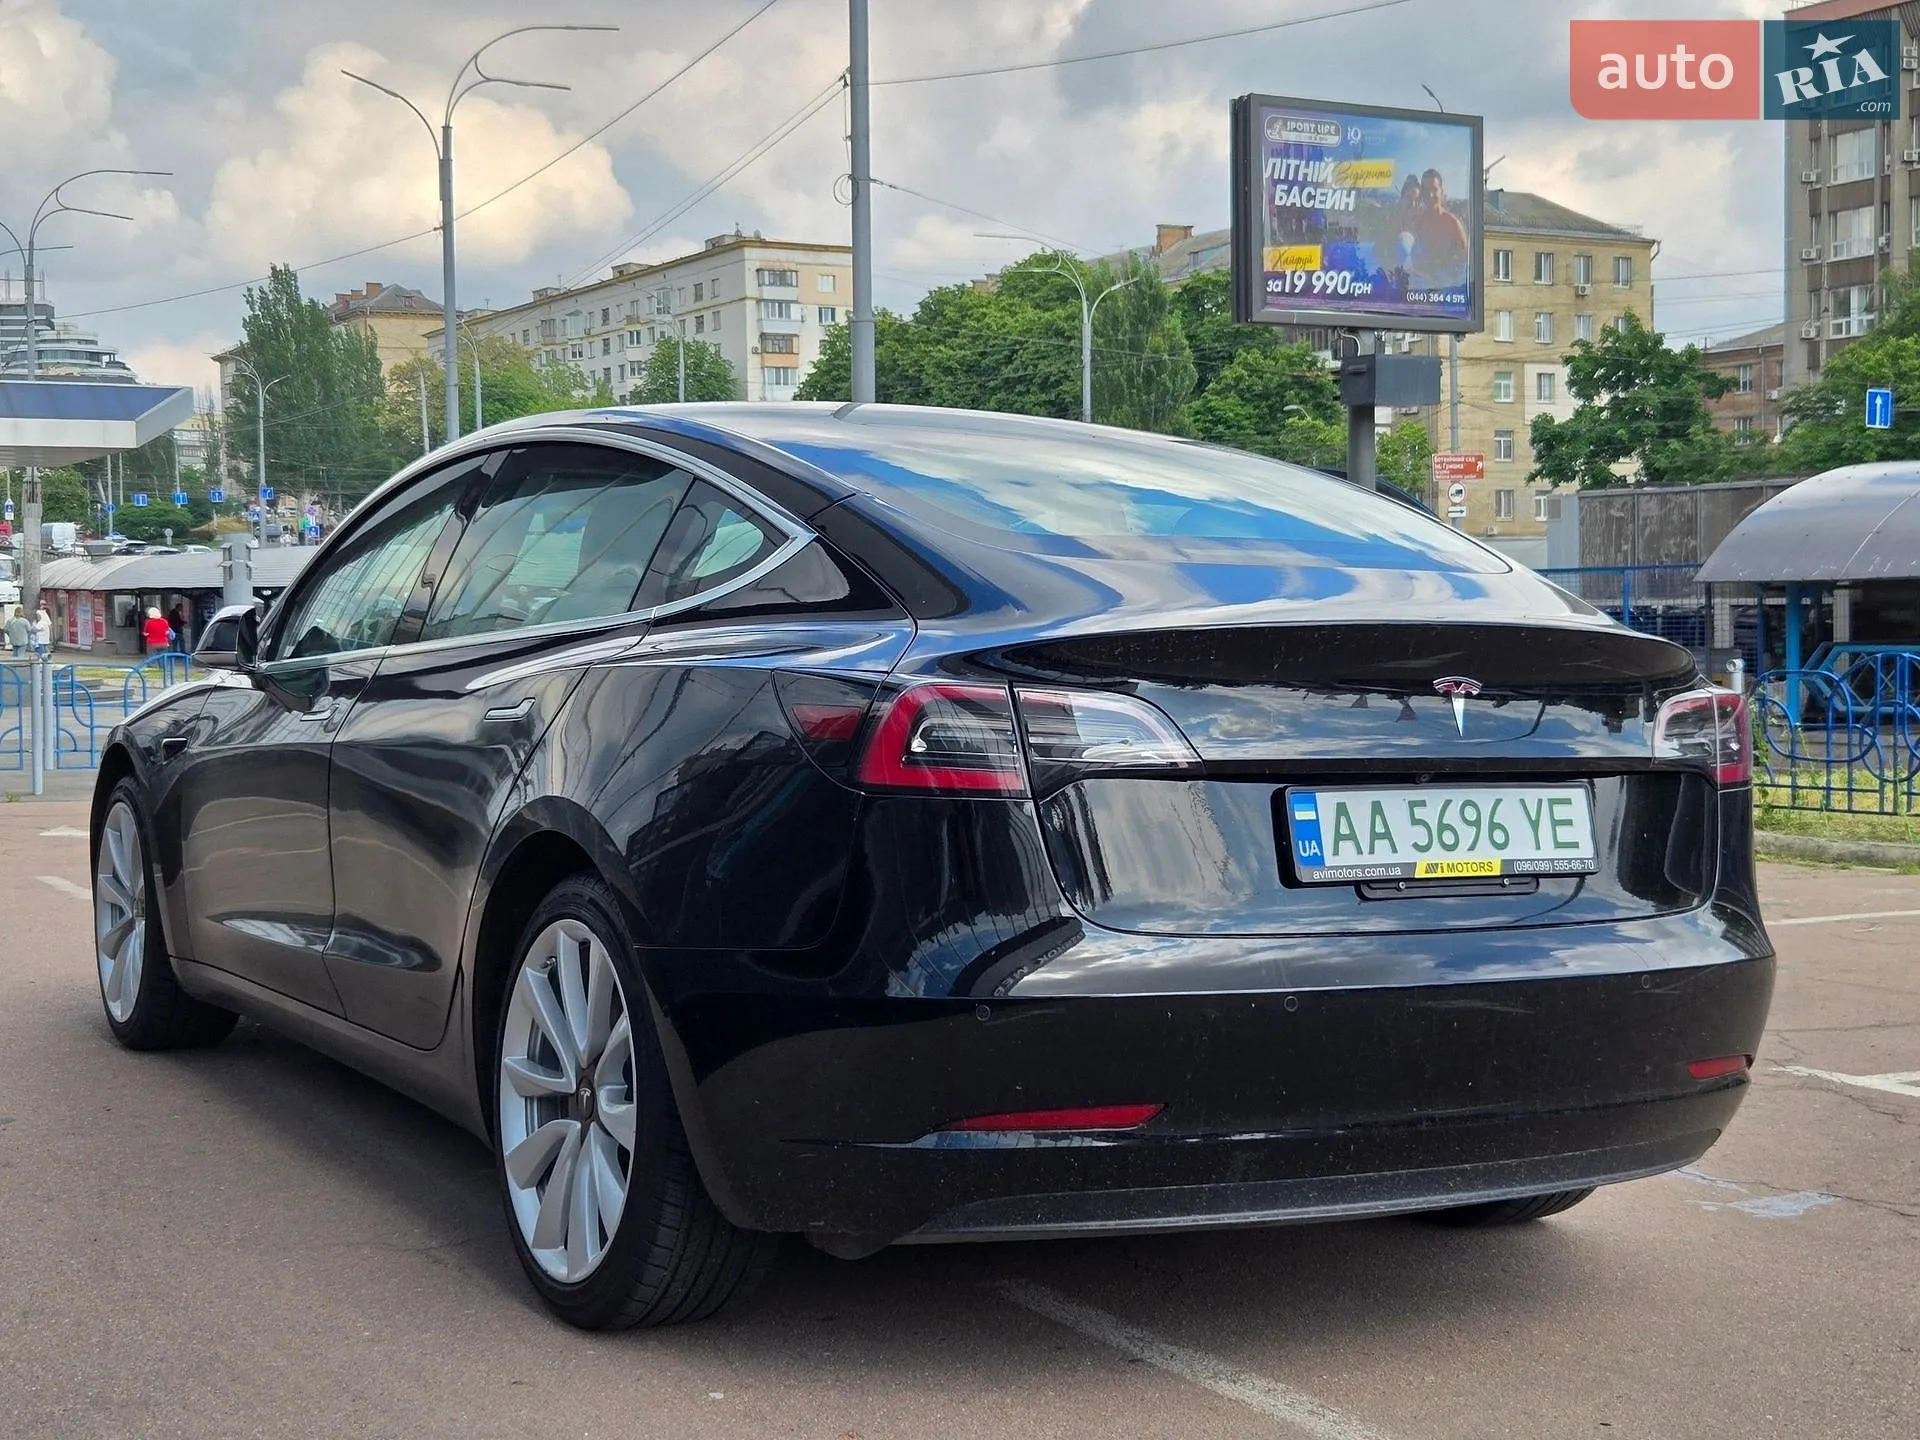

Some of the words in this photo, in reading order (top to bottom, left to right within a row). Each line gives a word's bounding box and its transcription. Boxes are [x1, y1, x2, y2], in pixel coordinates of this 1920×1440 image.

[1264, 157, 1335, 183] ЛІТНІЙ
[1274, 183, 1356, 212] БАСЕЙН
[1266, 279, 1282, 292] за
[1284, 269, 1306, 293] 19
[1311, 270, 1351, 295] 990
[1350, 282, 1372, 296] грн
[1406, 292, 1427, 302] (044)
[1429, 293, 1443, 303] 364
[1452, 294, 1465, 303] 575
[1332, 799, 1398, 856] AA
[1406, 798, 1510, 852] 5696
[1519, 797, 1580, 850] YE
[1298, 839, 1321, 858] UA
[1313, 866, 1402, 879] avimotors.com.ua
[1446, 861, 1494, 874] MOTORS
[1513, 861, 1552, 873] (096/099)
[1554, 859, 1595, 871] 555-66-70
